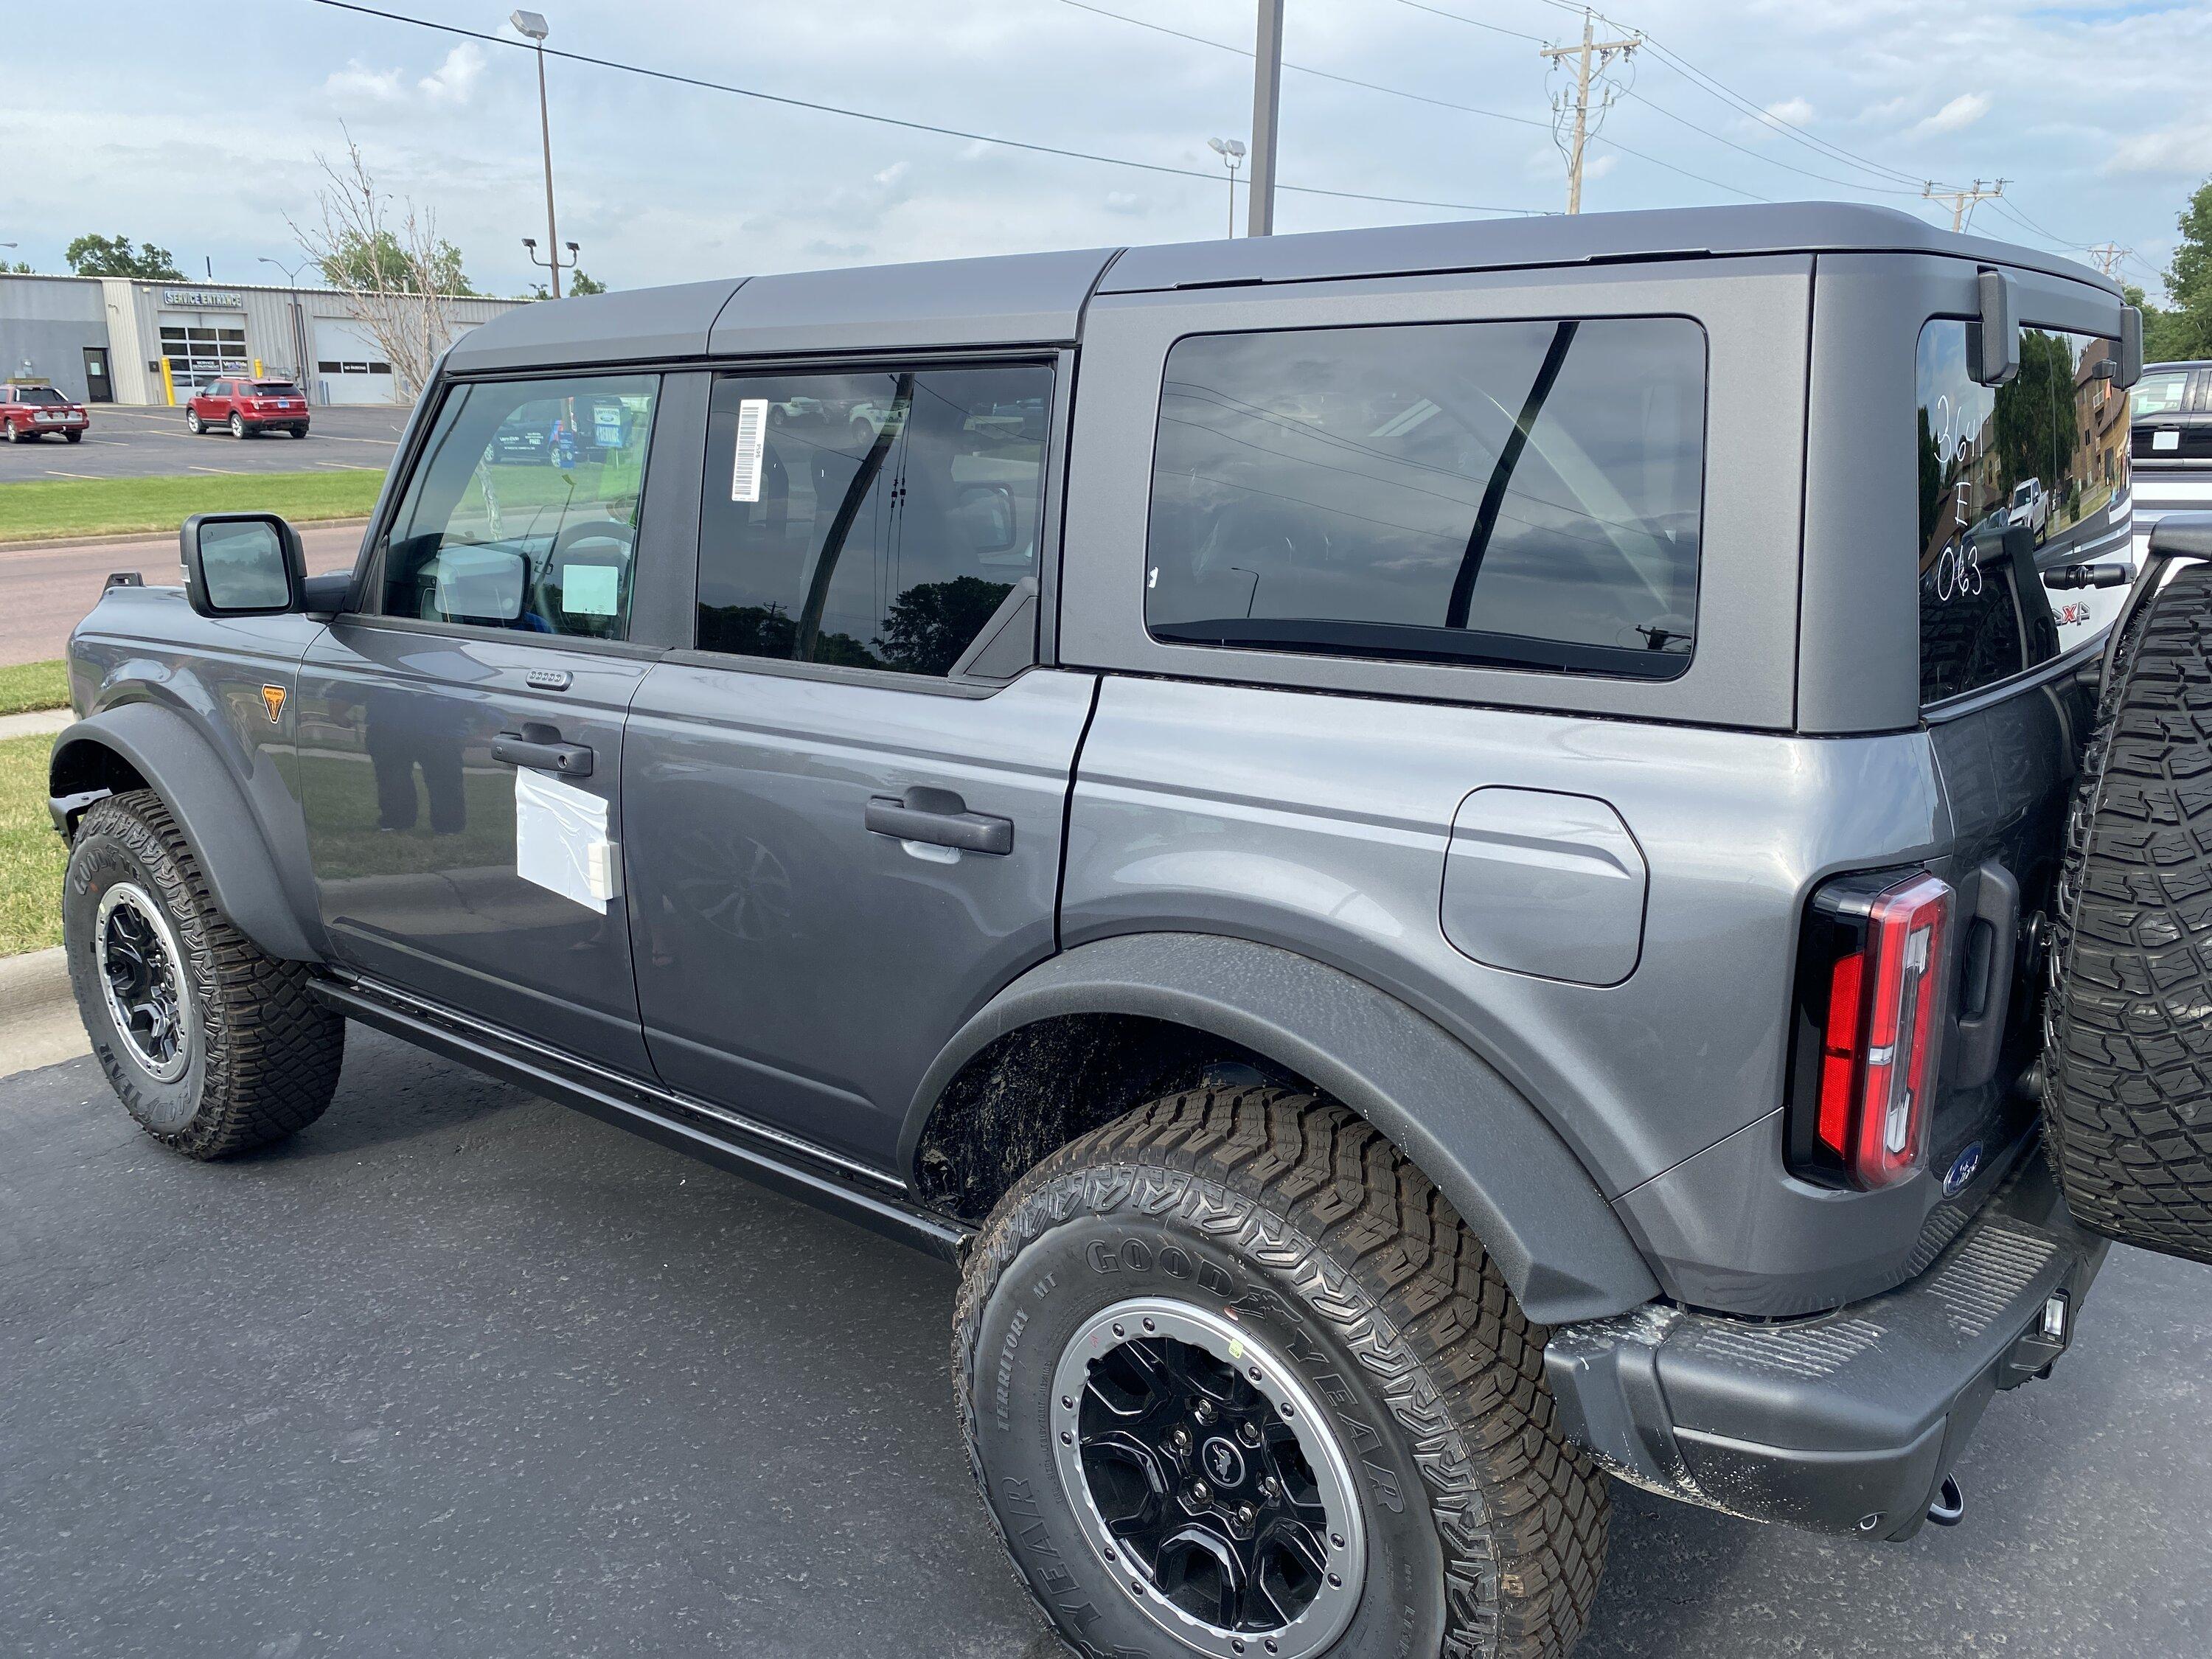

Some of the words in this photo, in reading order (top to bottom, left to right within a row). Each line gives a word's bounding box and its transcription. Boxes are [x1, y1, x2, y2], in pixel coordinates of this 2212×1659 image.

[167, 292, 201, 305] SERVICE
[202, 294, 241, 307] ENTRANCE
[1933, 394, 1983, 463] 3641
[1938, 546, 1983, 601] 063
[995, 1306, 1030, 1432] TERRITORY
[1032, 1272, 1058, 1301] MT
